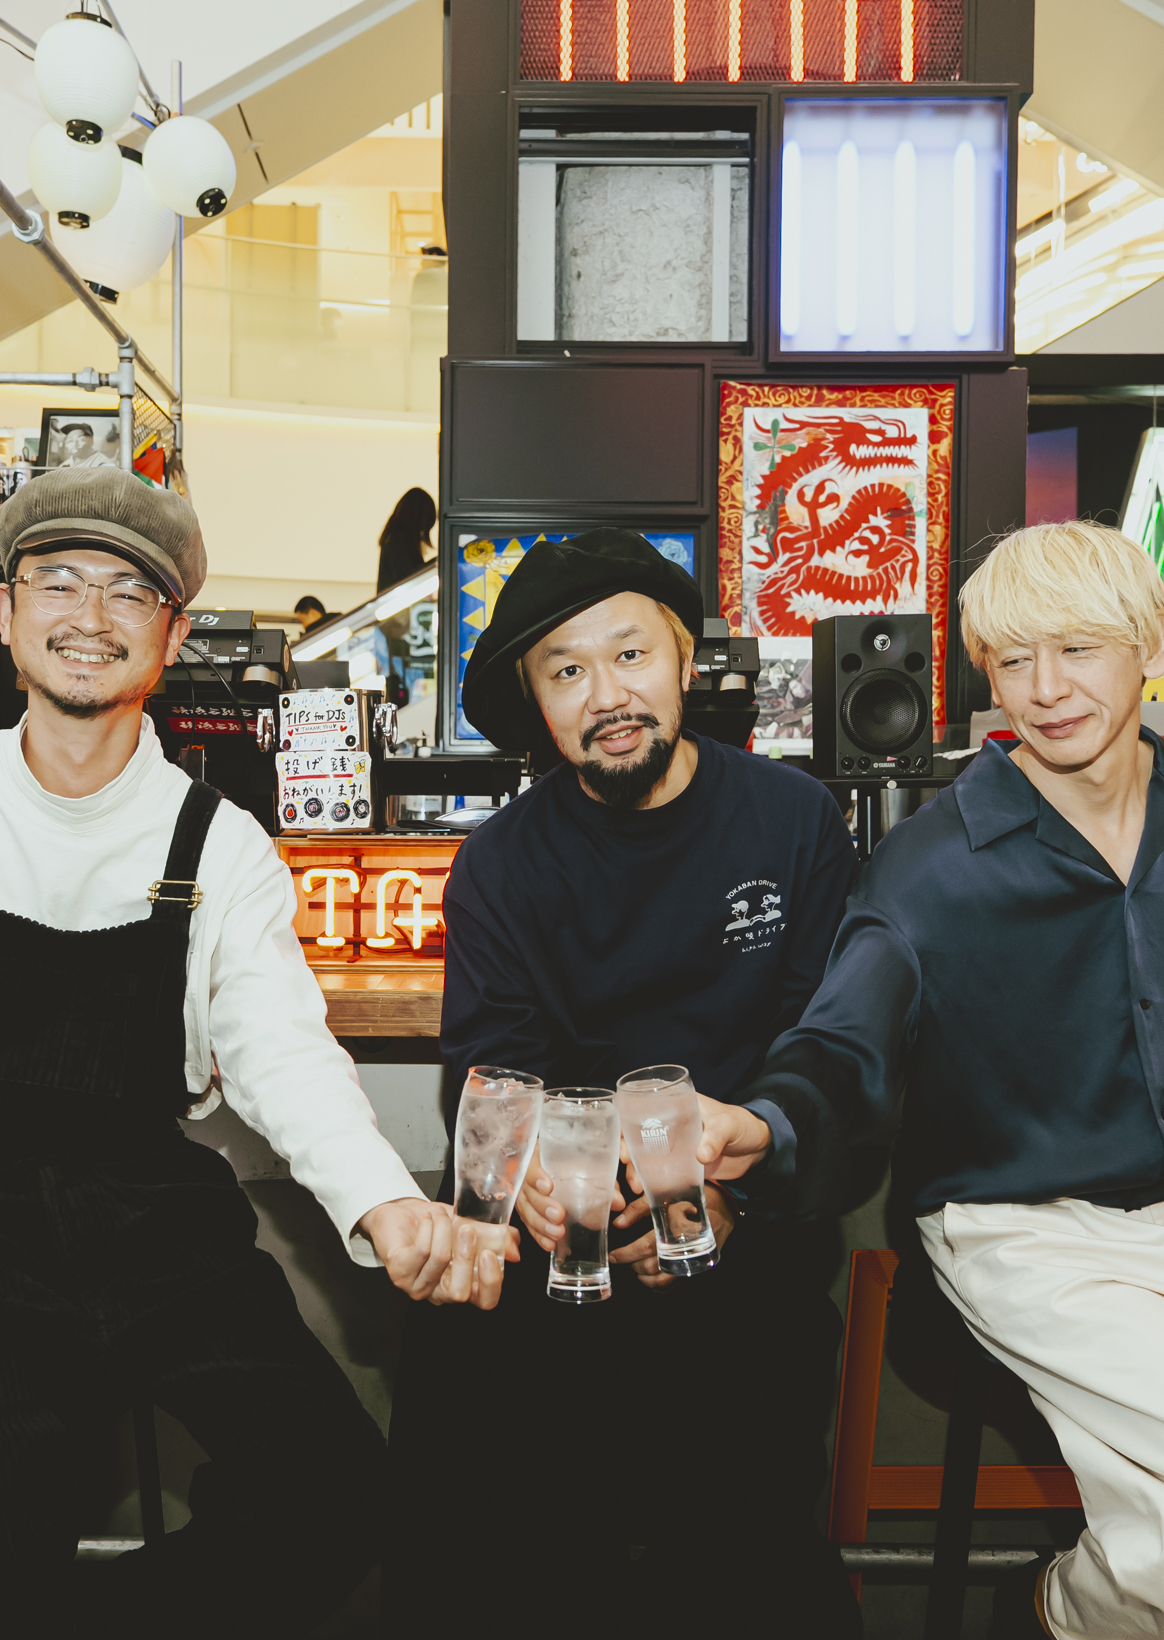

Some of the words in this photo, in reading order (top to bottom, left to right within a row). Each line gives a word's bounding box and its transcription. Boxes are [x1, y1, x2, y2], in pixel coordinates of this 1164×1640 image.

[285, 710, 311, 725] TIPS
[313, 711, 325, 721] for
[326, 709, 346, 721] DJs
[285, 756, 350, 776] 投げ銭
[725, 880, 757, 900] YOKABAN
[758, 879, 778, 890] DRIVE
[641, 1128, 667, 1137] KIRIN
